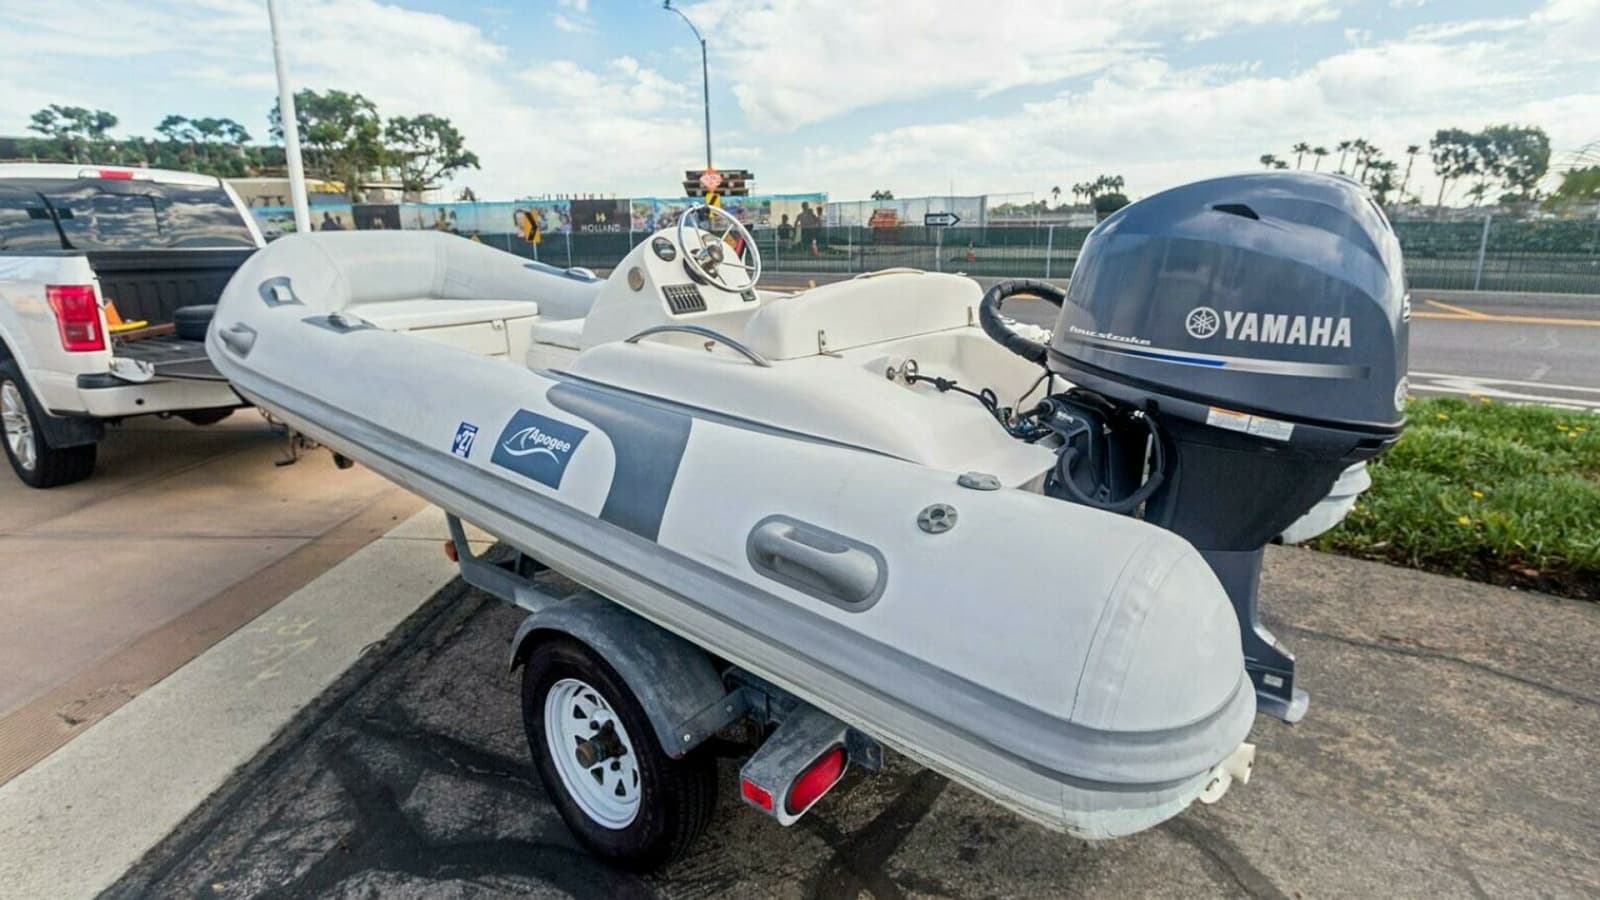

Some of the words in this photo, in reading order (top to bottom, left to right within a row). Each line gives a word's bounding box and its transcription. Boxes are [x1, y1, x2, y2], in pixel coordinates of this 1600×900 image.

[581, 223, 621, 233] HOLLAND
[1223, 310, 1352, 348] YAMAHA
[528, 428, 571, 453] Apogee
